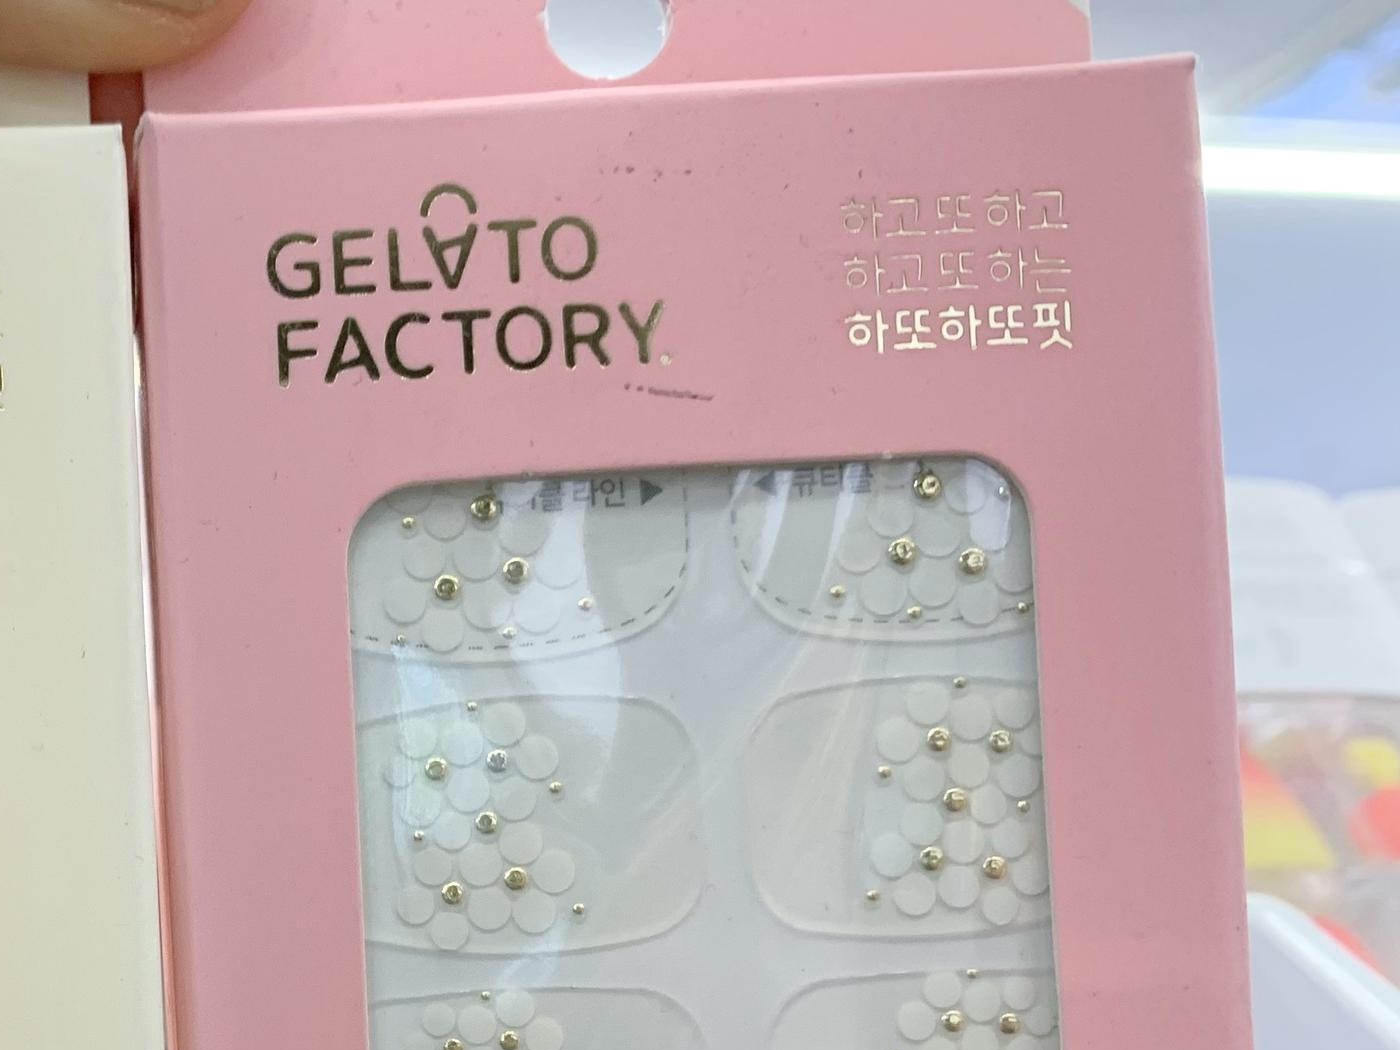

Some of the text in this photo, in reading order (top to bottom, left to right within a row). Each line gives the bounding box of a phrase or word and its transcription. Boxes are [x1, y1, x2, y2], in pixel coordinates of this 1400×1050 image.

[266, 183, 598, 298] GELATO
[840, 189, 1068, 241] 하고 또 하고
[843, 247, 1071, 296] 하고 또 하는
[844, 300, 1073, 354] 하또하또핏
